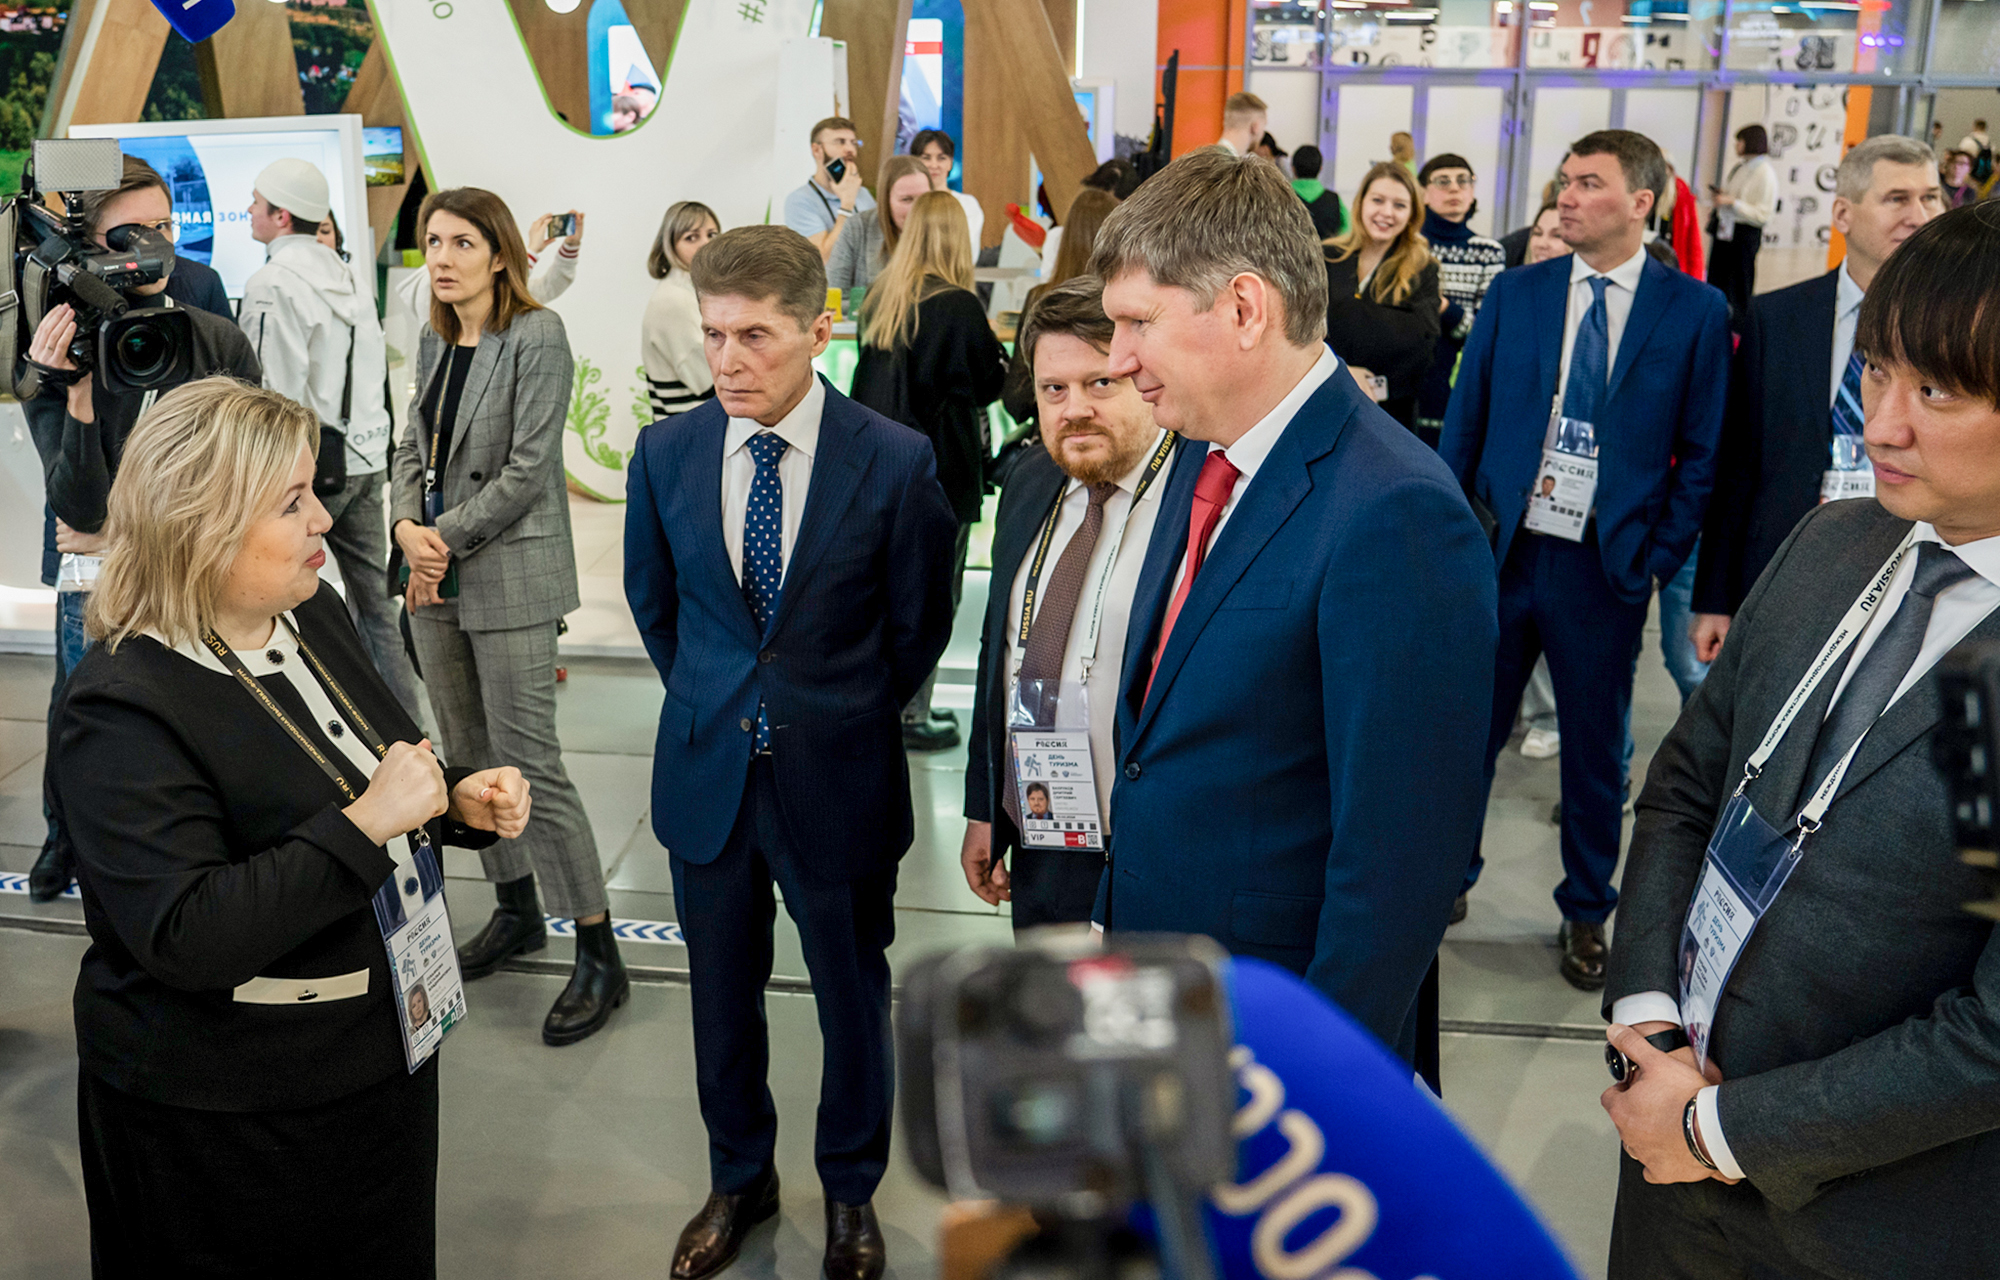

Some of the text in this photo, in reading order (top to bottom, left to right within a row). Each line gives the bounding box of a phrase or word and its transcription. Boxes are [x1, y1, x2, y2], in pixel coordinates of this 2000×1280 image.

[1544, 460, 1594, 479] РОССИЯ
[1860, 552, 1902, 612] RUSSIA.RU
[1021, 589, 1034, 640] RUSSIA.RU
[1765, 629, 1849, 748] МЕЖДУНАРОДНАЯ ВЫСТАВКА-ФОРУМ
[236, 668, 326, 764] МЕЖДУНАРОДНАЯ ВЫСТАВКА-ФОРУМ
[330, 681, 369, 731] ВЫСТАВКА-ФОРУМ
[1713, 890, 1735, 921] РОССИЯ
[407, 916, 431, 943] РОССИЯ
[1709, 924, 1726, 953] ТУРИЗМА
[1712, 915, 1723, 933] ДЕНЬ
[419, 934, 431, 949] ДЕНЬ
[420, 934, 441, 955] ТУРИЗМА
